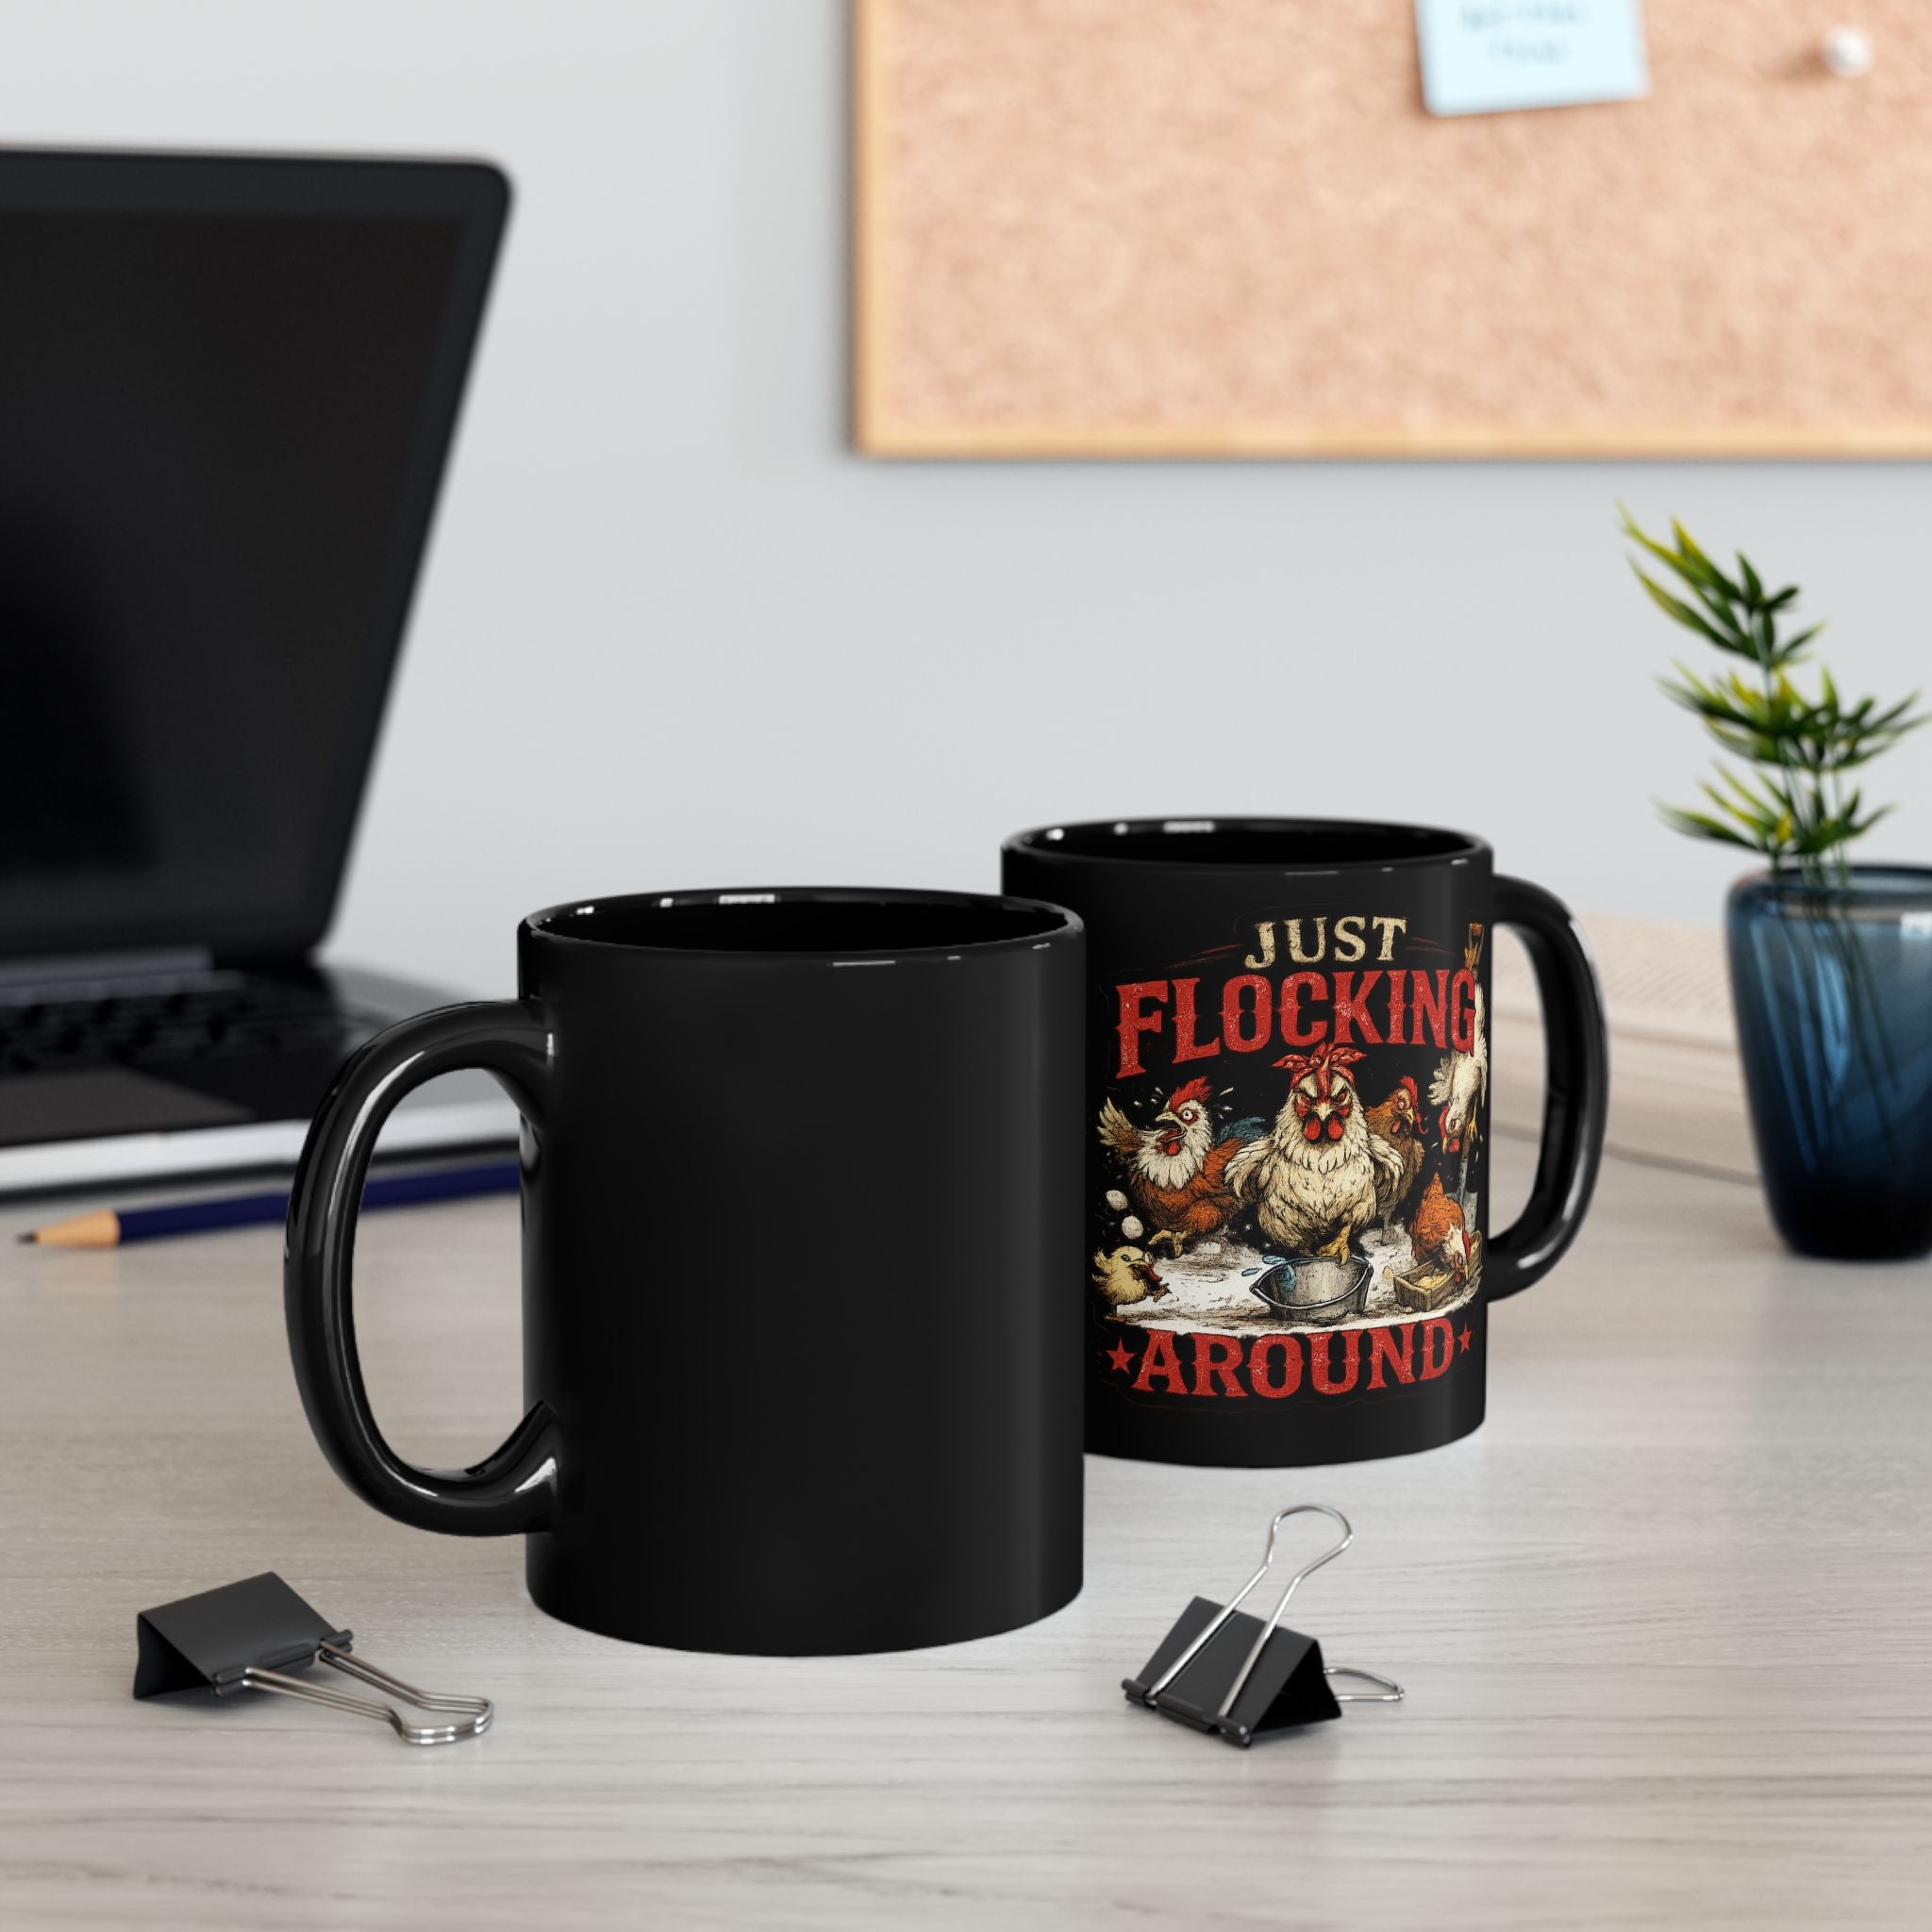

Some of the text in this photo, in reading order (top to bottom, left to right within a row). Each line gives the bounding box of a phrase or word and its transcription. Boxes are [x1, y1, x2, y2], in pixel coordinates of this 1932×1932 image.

[1244, 916, 1407, 969] JUST
[1114, 969, 1477, 1079] FLOCKING
[1132, 1317, 1455, 1399] AROUND
